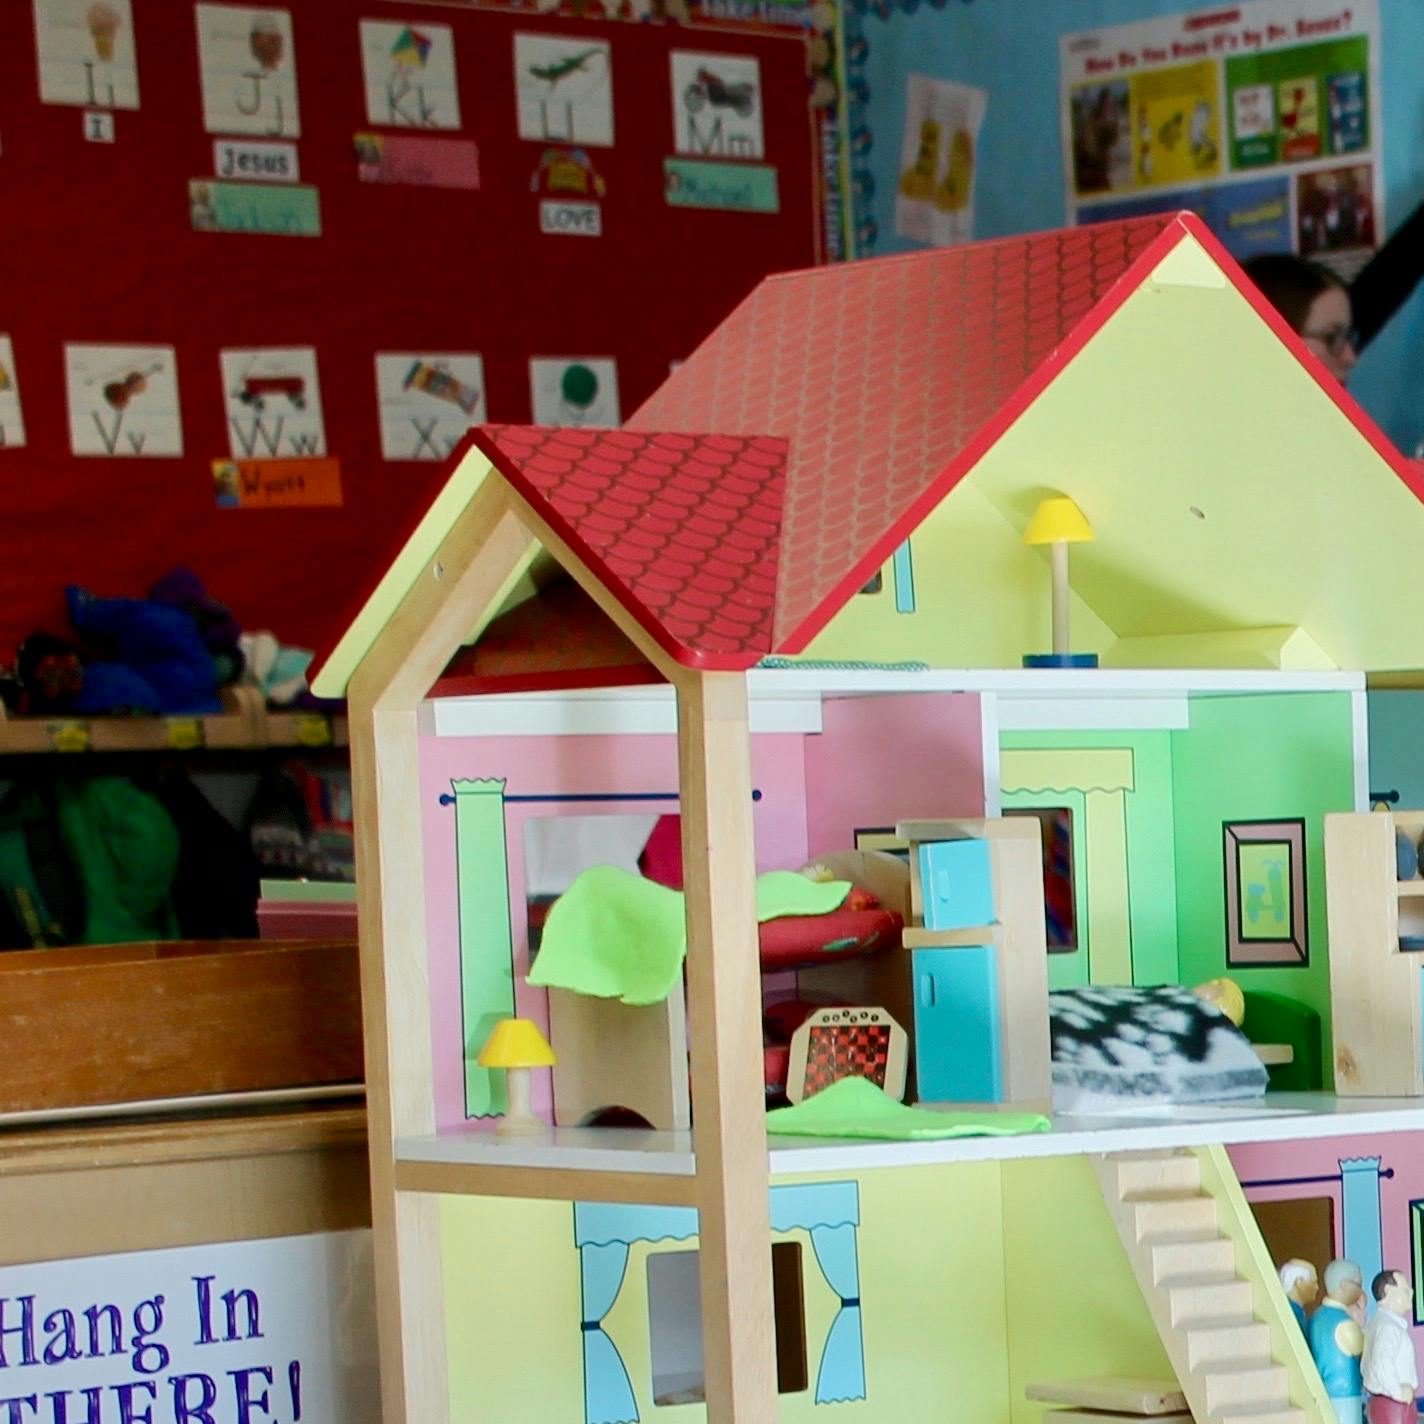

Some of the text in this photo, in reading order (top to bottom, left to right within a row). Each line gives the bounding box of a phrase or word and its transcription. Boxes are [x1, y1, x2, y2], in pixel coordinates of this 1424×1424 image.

[546, 206, 599, 231] LOVE
[0, 1274, 265, 1375] Hang In
